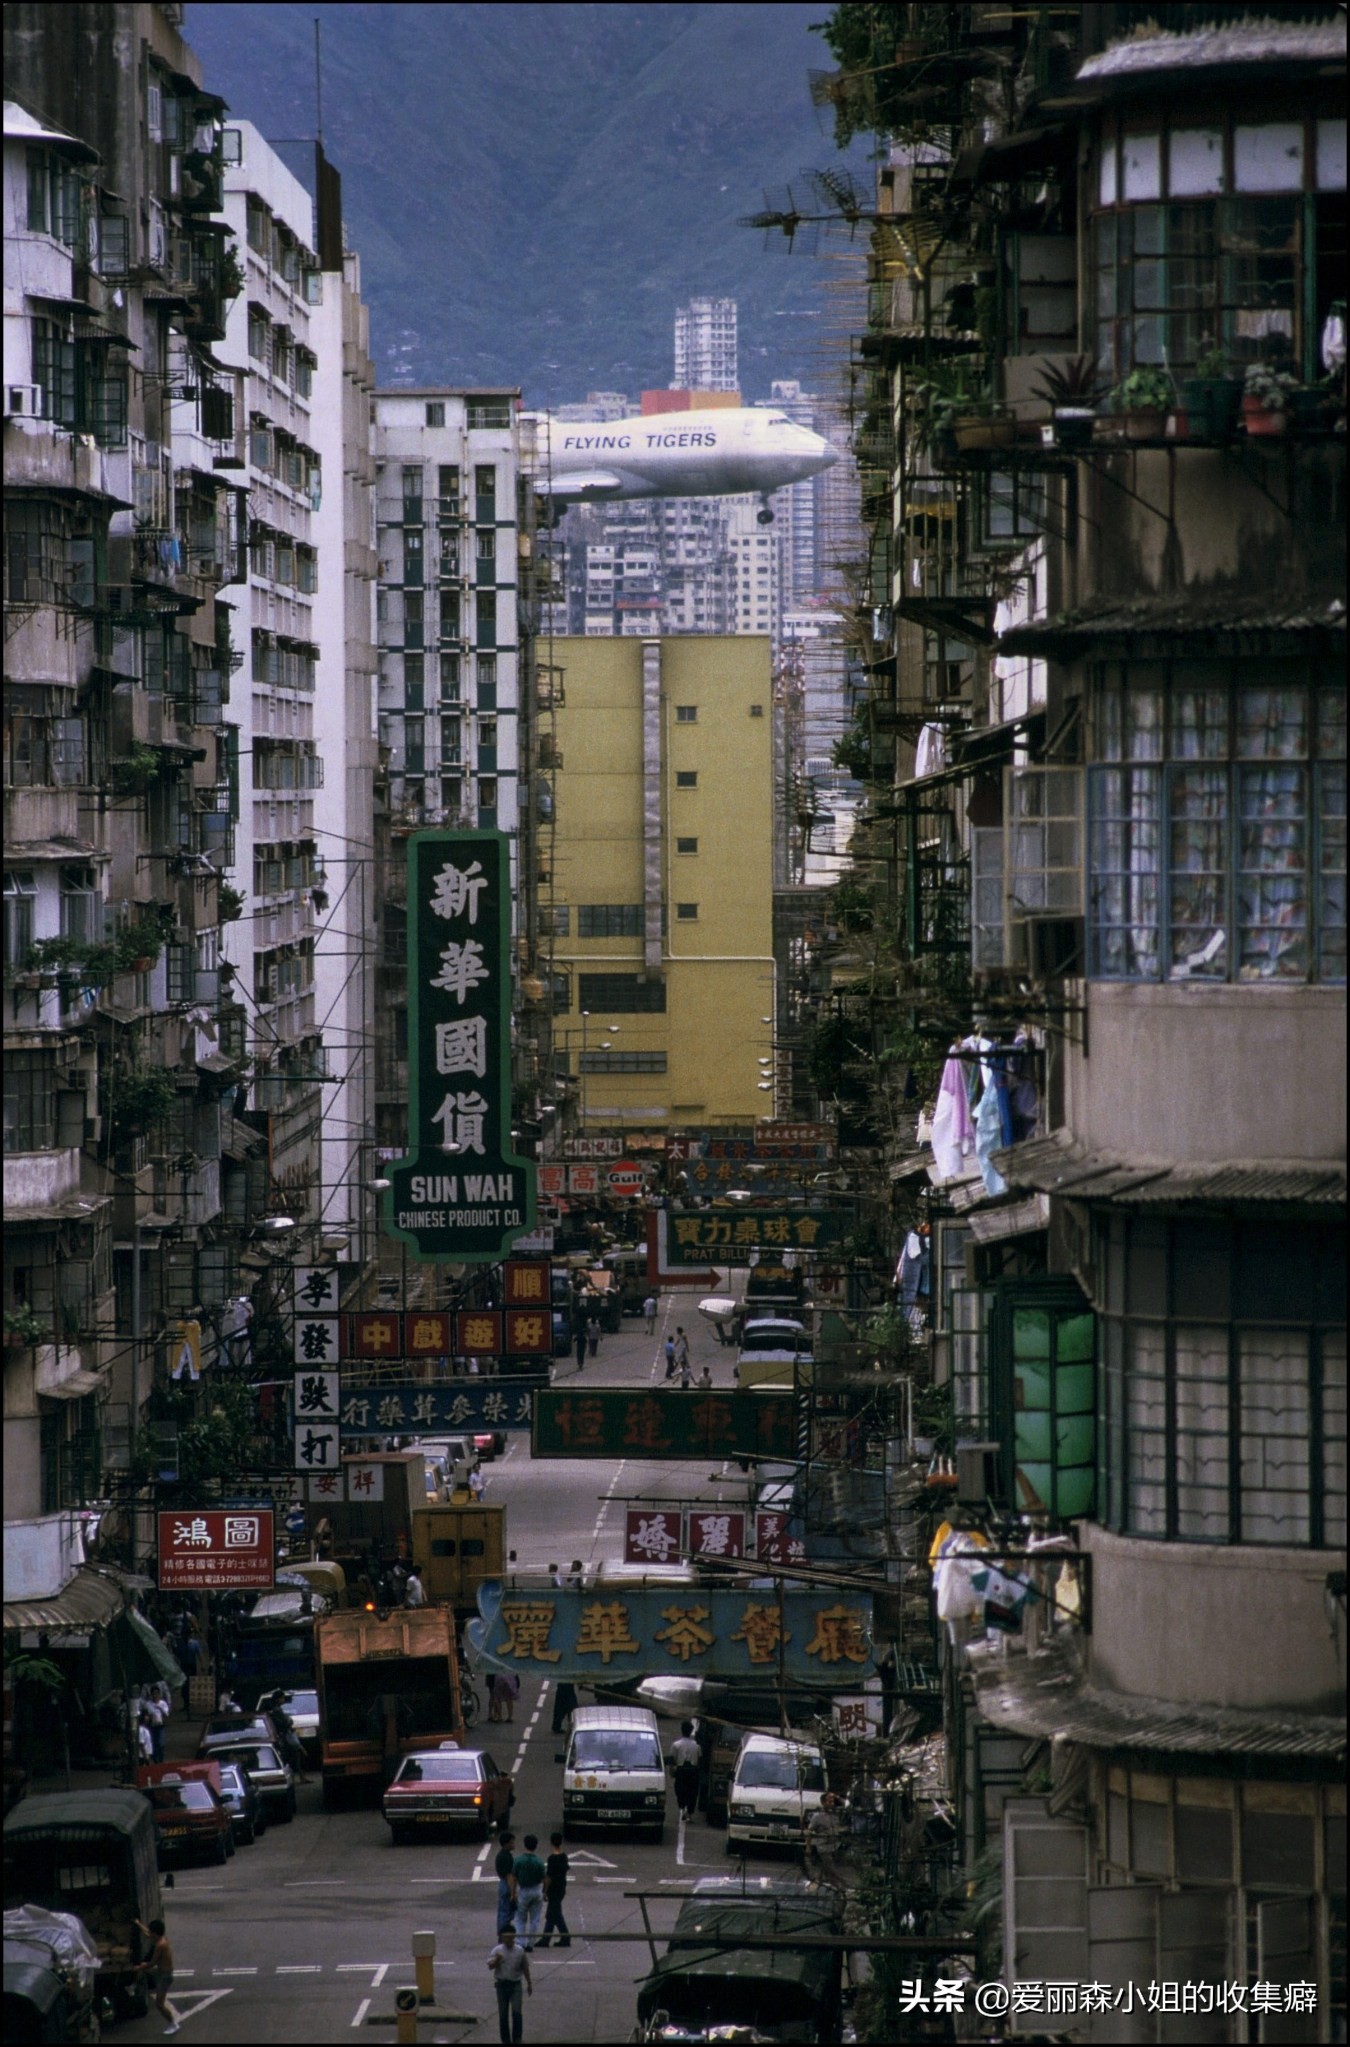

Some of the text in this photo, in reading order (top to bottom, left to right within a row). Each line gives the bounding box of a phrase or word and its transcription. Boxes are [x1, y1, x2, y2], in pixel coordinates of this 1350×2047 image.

[564, 432, 717, 450] FLYING TIGERS
[429, 860, 489, 1155] 新華國貨
[411, 1174, 513, 1203] SUN WAH
[609, 1173, 643, 1184] Gulf
[399, 1208, 522, 1228] CHINESE PRODUCT CO.
[674, 1216, 821, 1245] 寶力桌球會
[684, 1249, 716, 1259] PRAT
[720, 1249, 771, 1260] BILLID
[513, 1268, 542, 1298] 順
[300, 1271, 333, 1465] 李發跌打
[172, 1516, 259, 1549] 鴻圖
[497, 1600, 872, 1664] 麗華茶餐廳
[839, 1704, 867, 1733] 明
